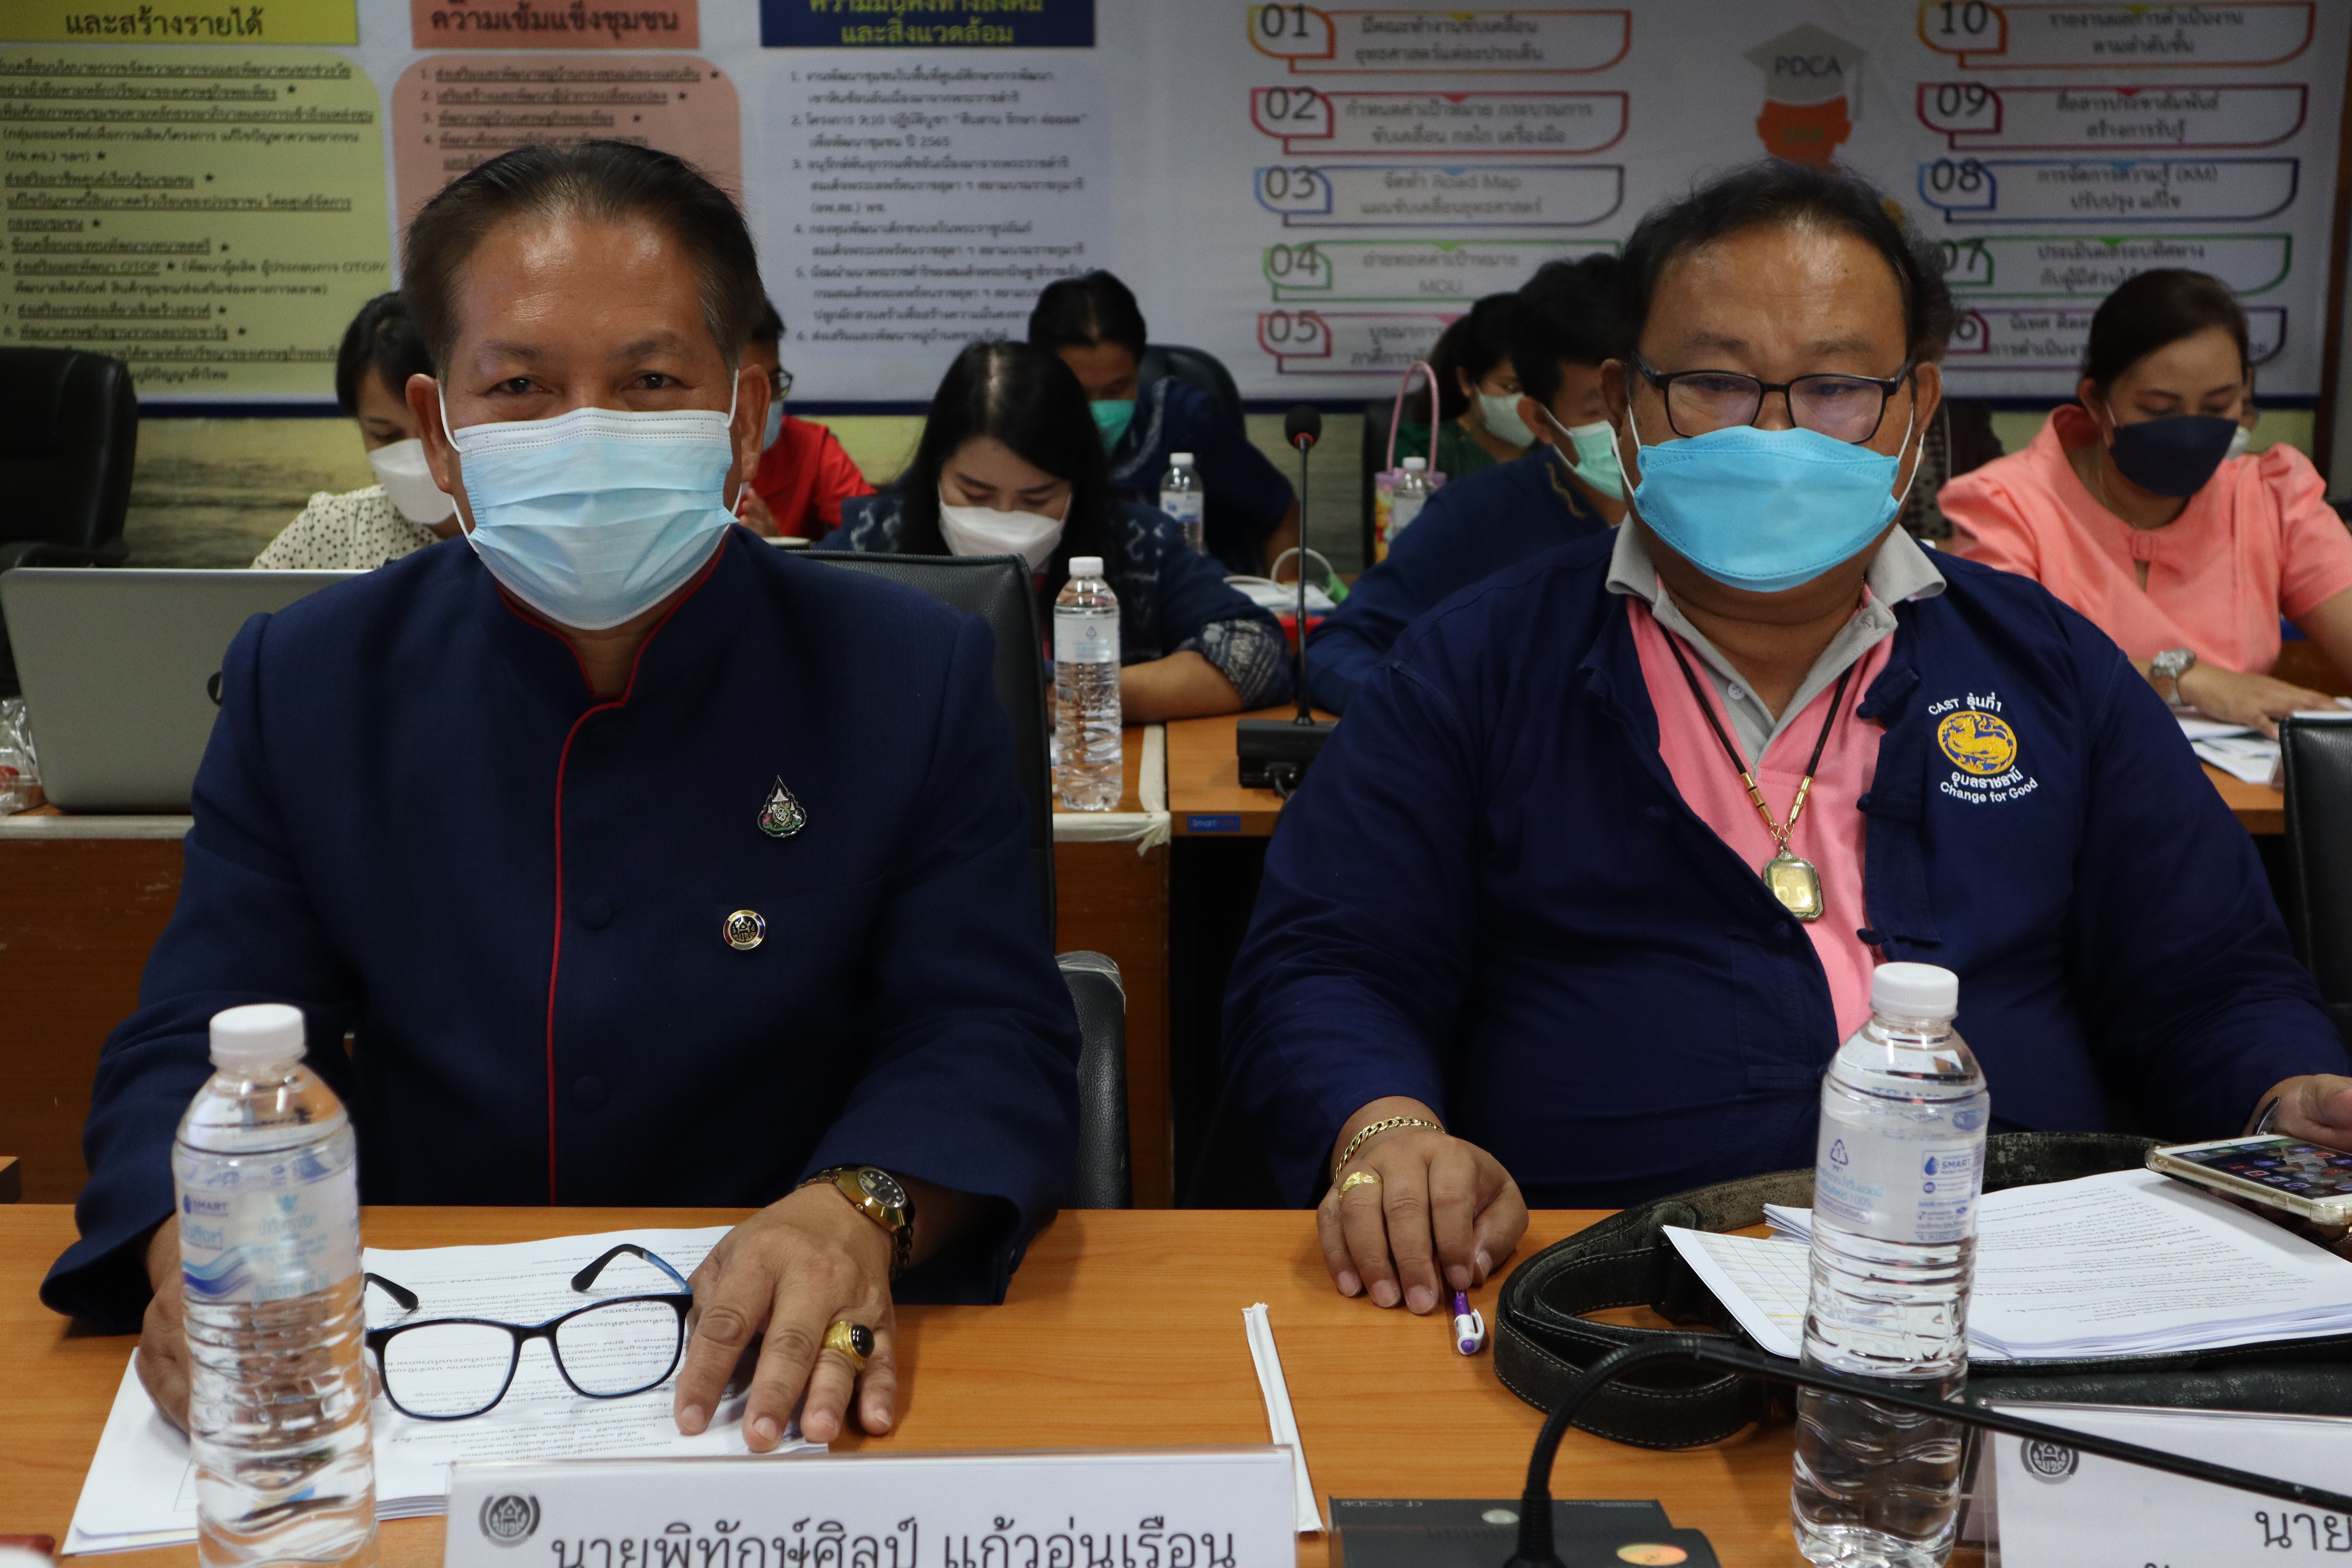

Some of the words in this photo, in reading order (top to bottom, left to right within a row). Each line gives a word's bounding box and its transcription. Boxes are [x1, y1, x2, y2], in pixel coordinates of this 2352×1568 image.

[66, 7, 264, 36] และสร้างรายได้
[432, 2, 679, 39] ความเข้มแข็งชุมชน
[841, 17, 1014, 43] และสิ่งแวดล้อม
[1261, 3, 1308, 38] 01
[1940, 1, 1987, 35] 10
[1774, 55, 1843, 77] PDCA
[1266, 85, 1317, 120] 02
[1937, 82, 1988, 118] 09
[920, 136, 951, 147] 2565
[1265, 166, 1315, 200] 03
[1432, 175, 1478, 189] Road
[1483, 175, 1522, 192] Map
[1932, 159, 1981, 192] 08
[2176, 165, 2218, 183] (KM)
[1270, 243, 1319, 276] 04
[1419, 279, 1463, 293] MOU
[1268, 310, 1317, 343] 05
[1928, 698, 1959, 715] CAST
[1940, 781, 1987, 804] Change
[1989, 791, 2007, 802] for
[2009, 777, 2039, 799] Good
[1951, 765, 2024, 787] อุบลราชธานี
[1942, 1158, 1971, 1169] SMART
[551, 1516, 917, 1568] นายพิทักษ์ศิลป์
[943, 1514, 1236, 1568] แก้วอ่นเรือน
[2255, 1509, 2352, 1552] นาย
